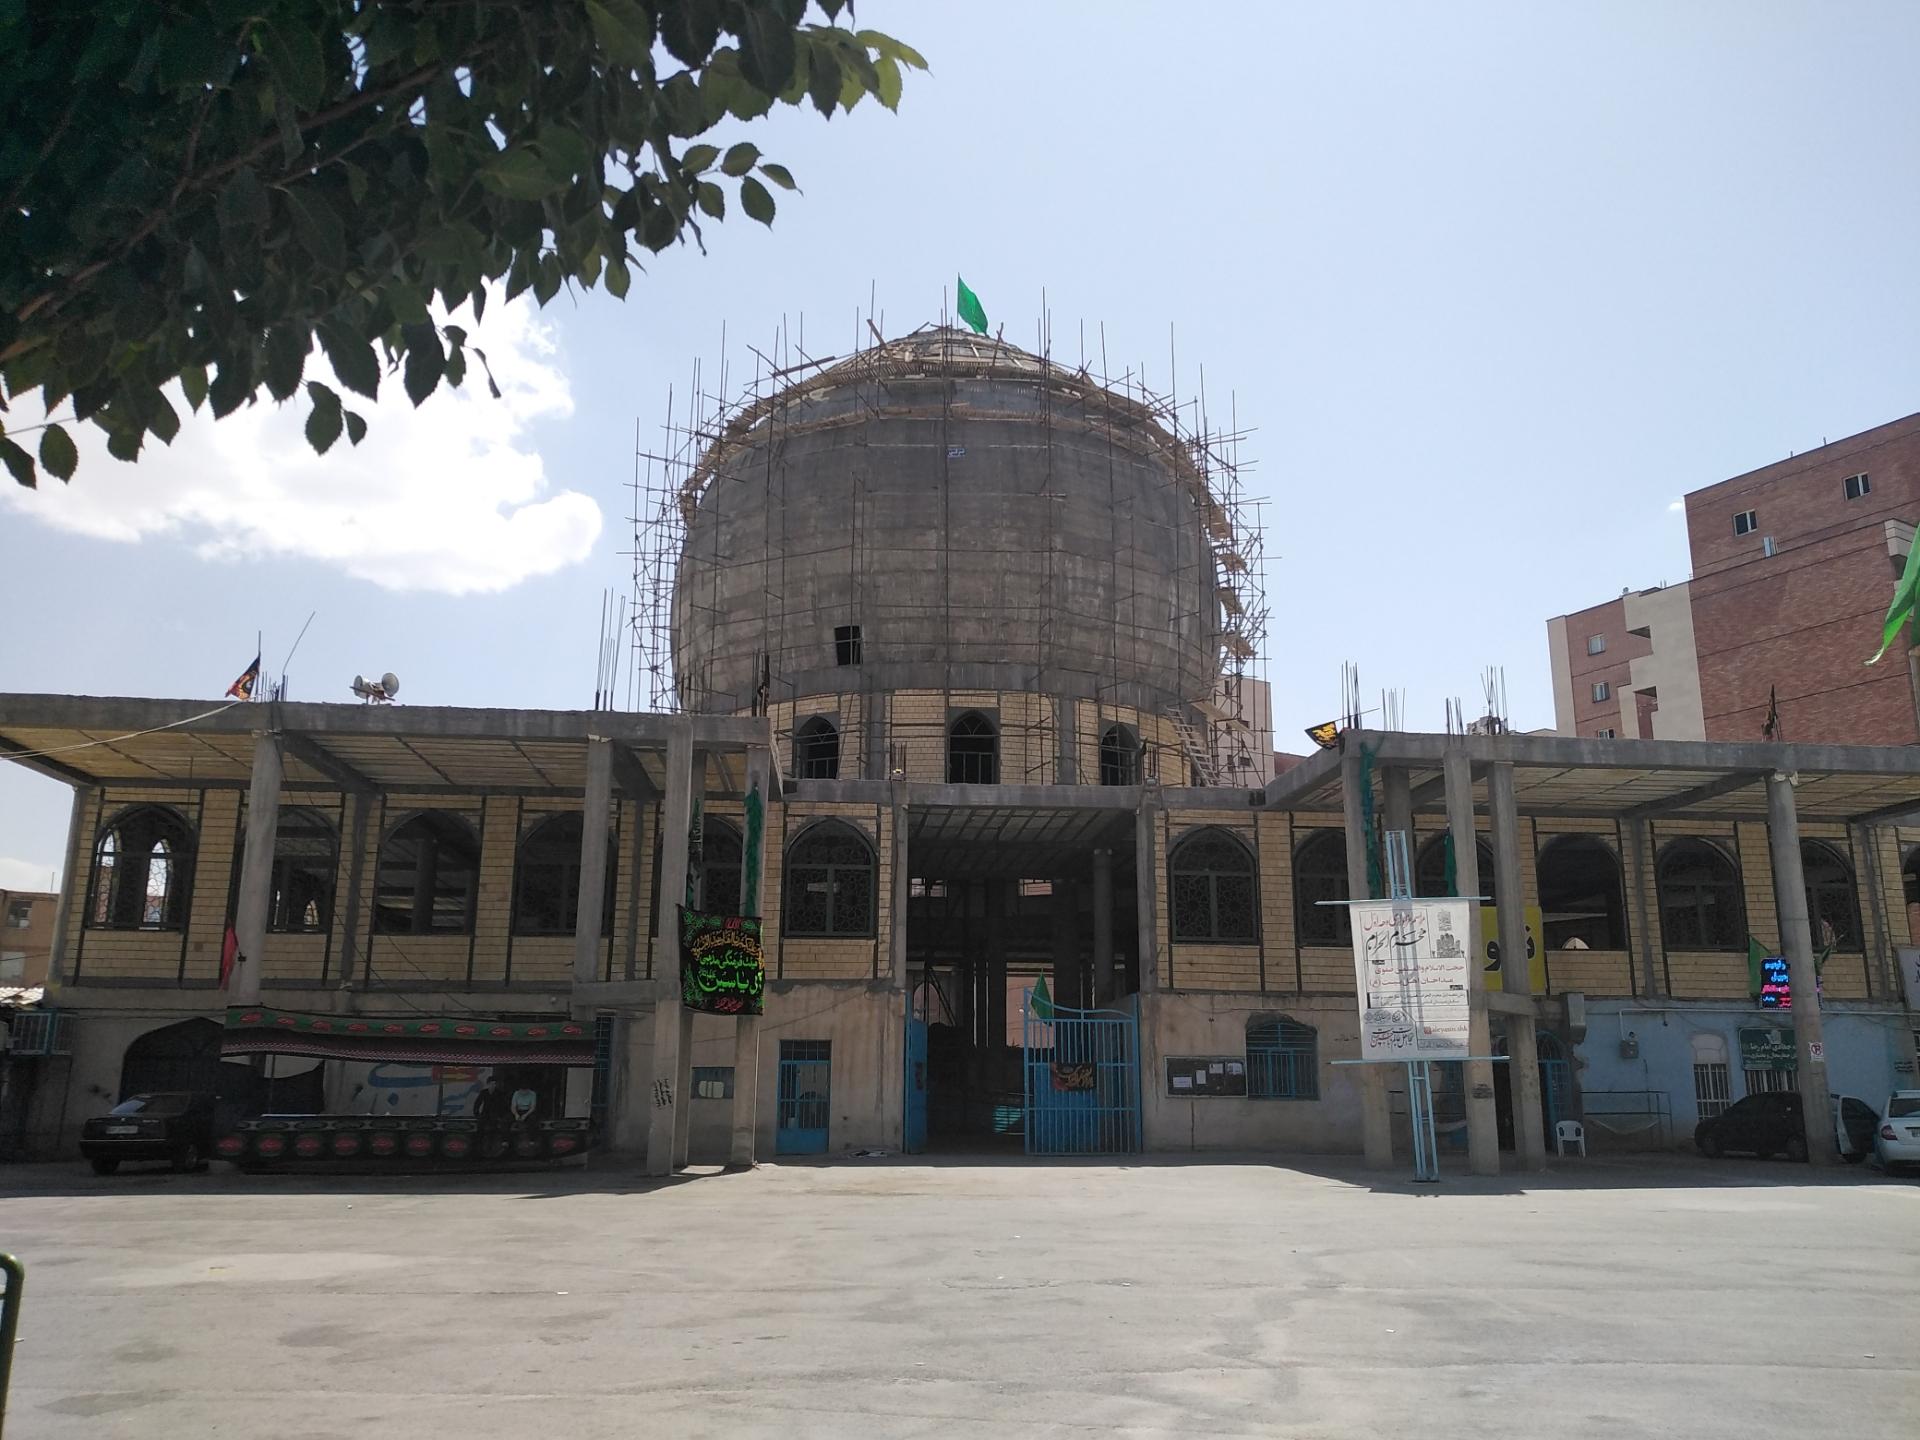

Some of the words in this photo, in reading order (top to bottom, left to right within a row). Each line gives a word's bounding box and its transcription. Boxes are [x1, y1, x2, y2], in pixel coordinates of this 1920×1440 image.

[719, 949, 743, 969] فرهنگی
[1403, 977, 1420, 987] اهل
[1420, 976, 1454, 986] مداحان
